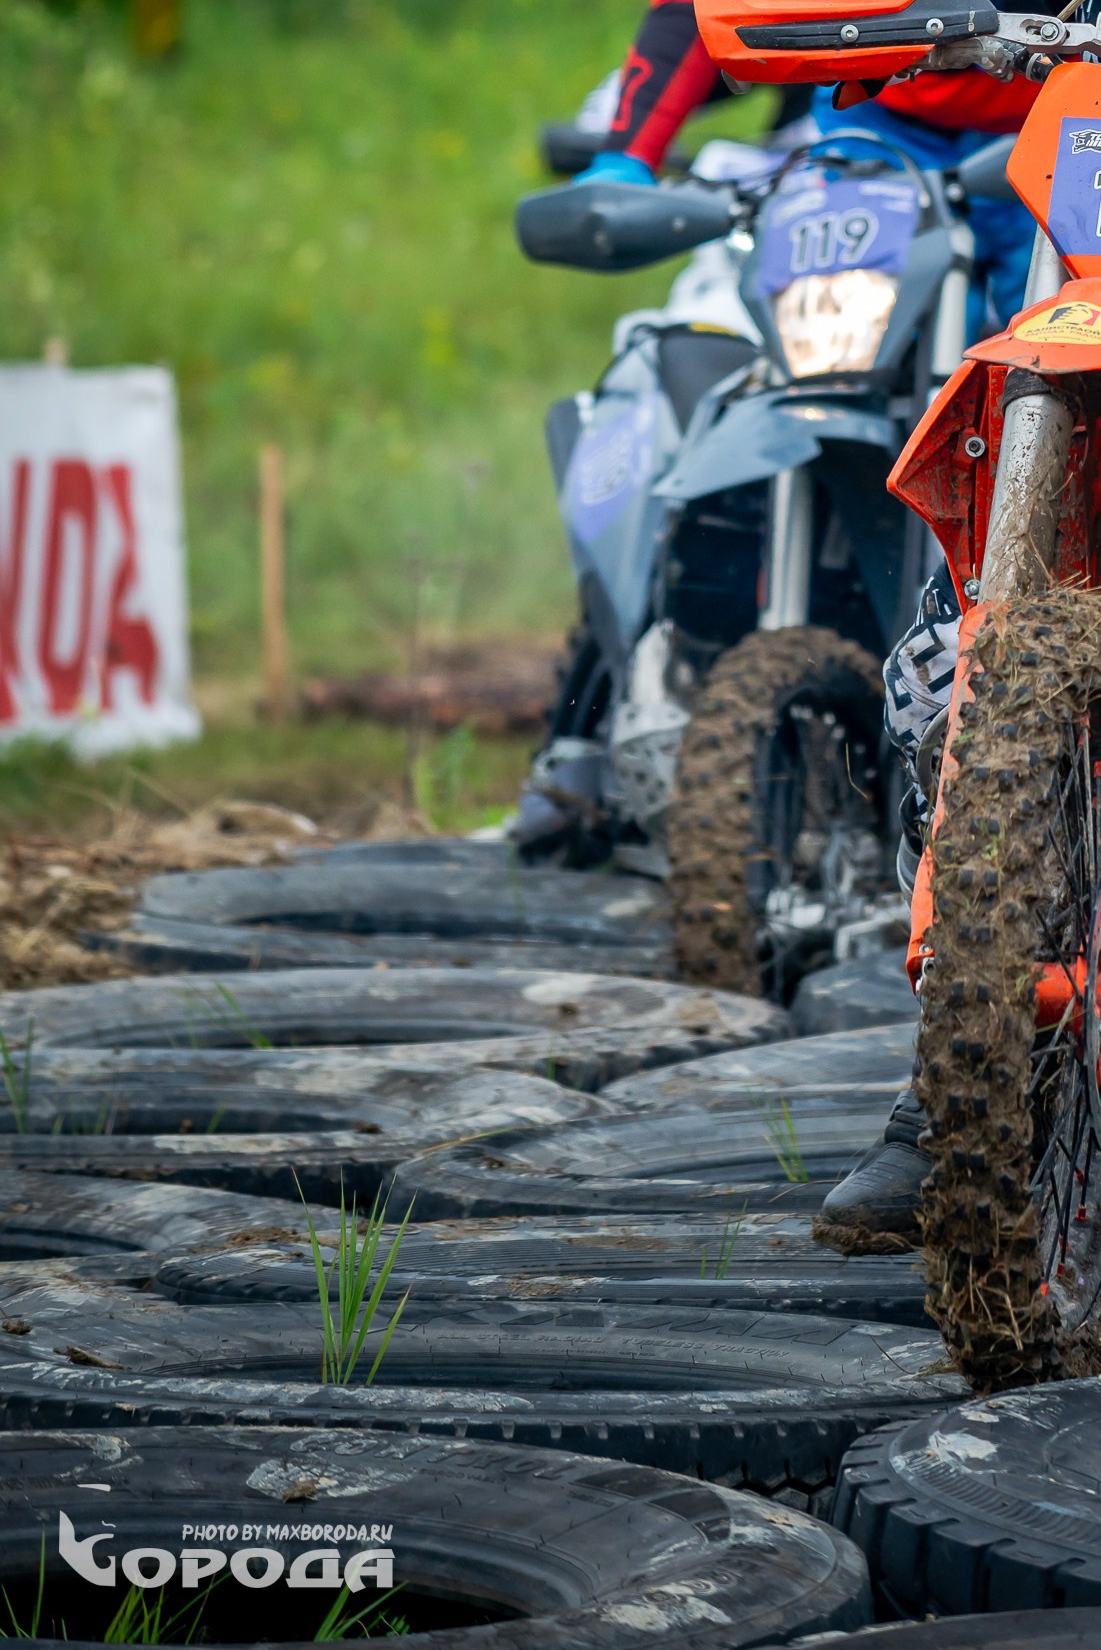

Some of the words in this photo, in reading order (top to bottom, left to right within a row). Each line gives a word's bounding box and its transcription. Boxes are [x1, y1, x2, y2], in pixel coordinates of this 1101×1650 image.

[789, 207, 879, 273] 119
[475, 1333, 531, 1342] STEEL
[537, 1334, 604, 1344] RADIAL
[621, 1337, 706, 1350] TUBELESS
[712, 1343, 791, 1358] TRACTION
[289, 1430, 576, 1481] CONTROL
